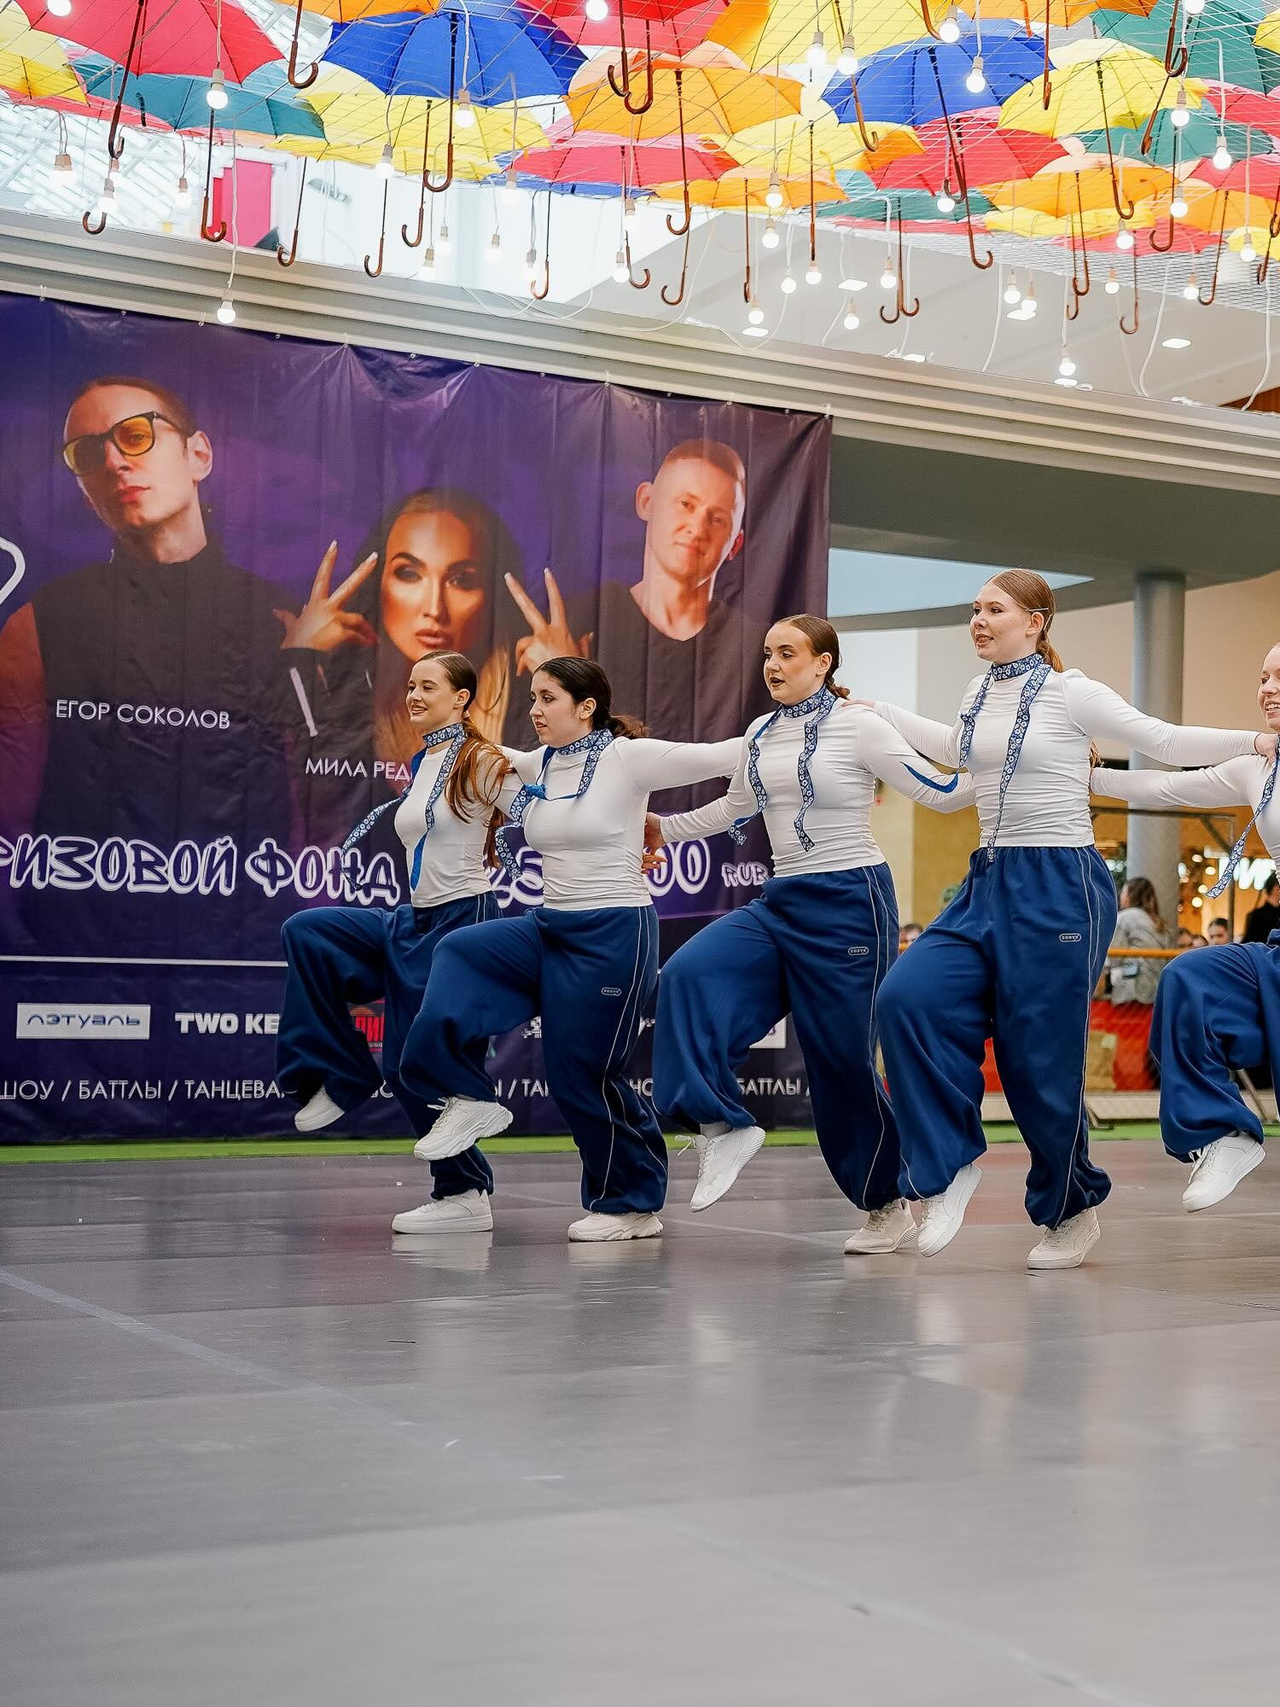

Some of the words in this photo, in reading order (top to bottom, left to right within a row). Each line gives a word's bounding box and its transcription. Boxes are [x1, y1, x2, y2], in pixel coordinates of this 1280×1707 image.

[55, 698, 110, 721] ЕГОР
[116, 703, 231, 730] СОКОЛОВ
[305, 757, 368, 778] МИЛА
[373, 760, 413, 782] РЕД
[245, 837, 401, 906] ФОНД
[174, 1012, 239, 1034] TWO
[79, 1079, 161, 1100] БАТТЛЫ
[184, 1079, 285, 1101] ТАНЦЕВА
